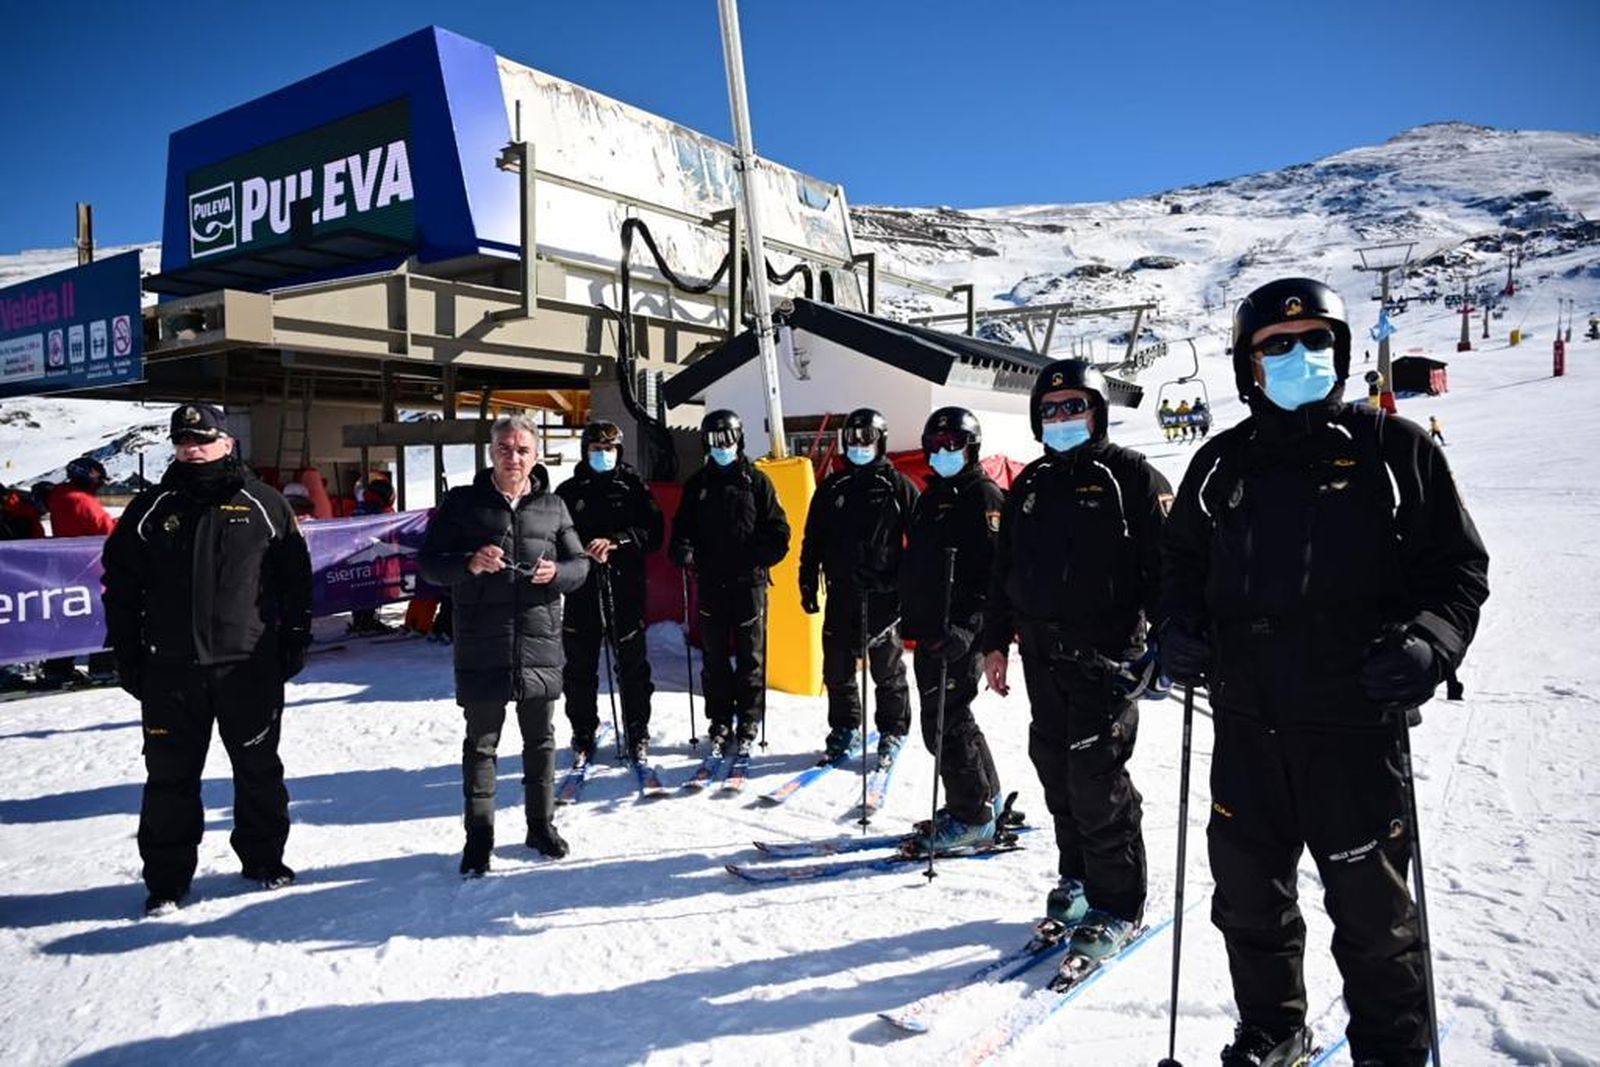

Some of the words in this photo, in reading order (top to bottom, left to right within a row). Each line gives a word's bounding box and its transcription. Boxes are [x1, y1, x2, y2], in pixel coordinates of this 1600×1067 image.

[194, 195, 231, 221] PULEVA
[0, 288, 59, 332] Veleta
[325, 564, 372, 585] sierra
